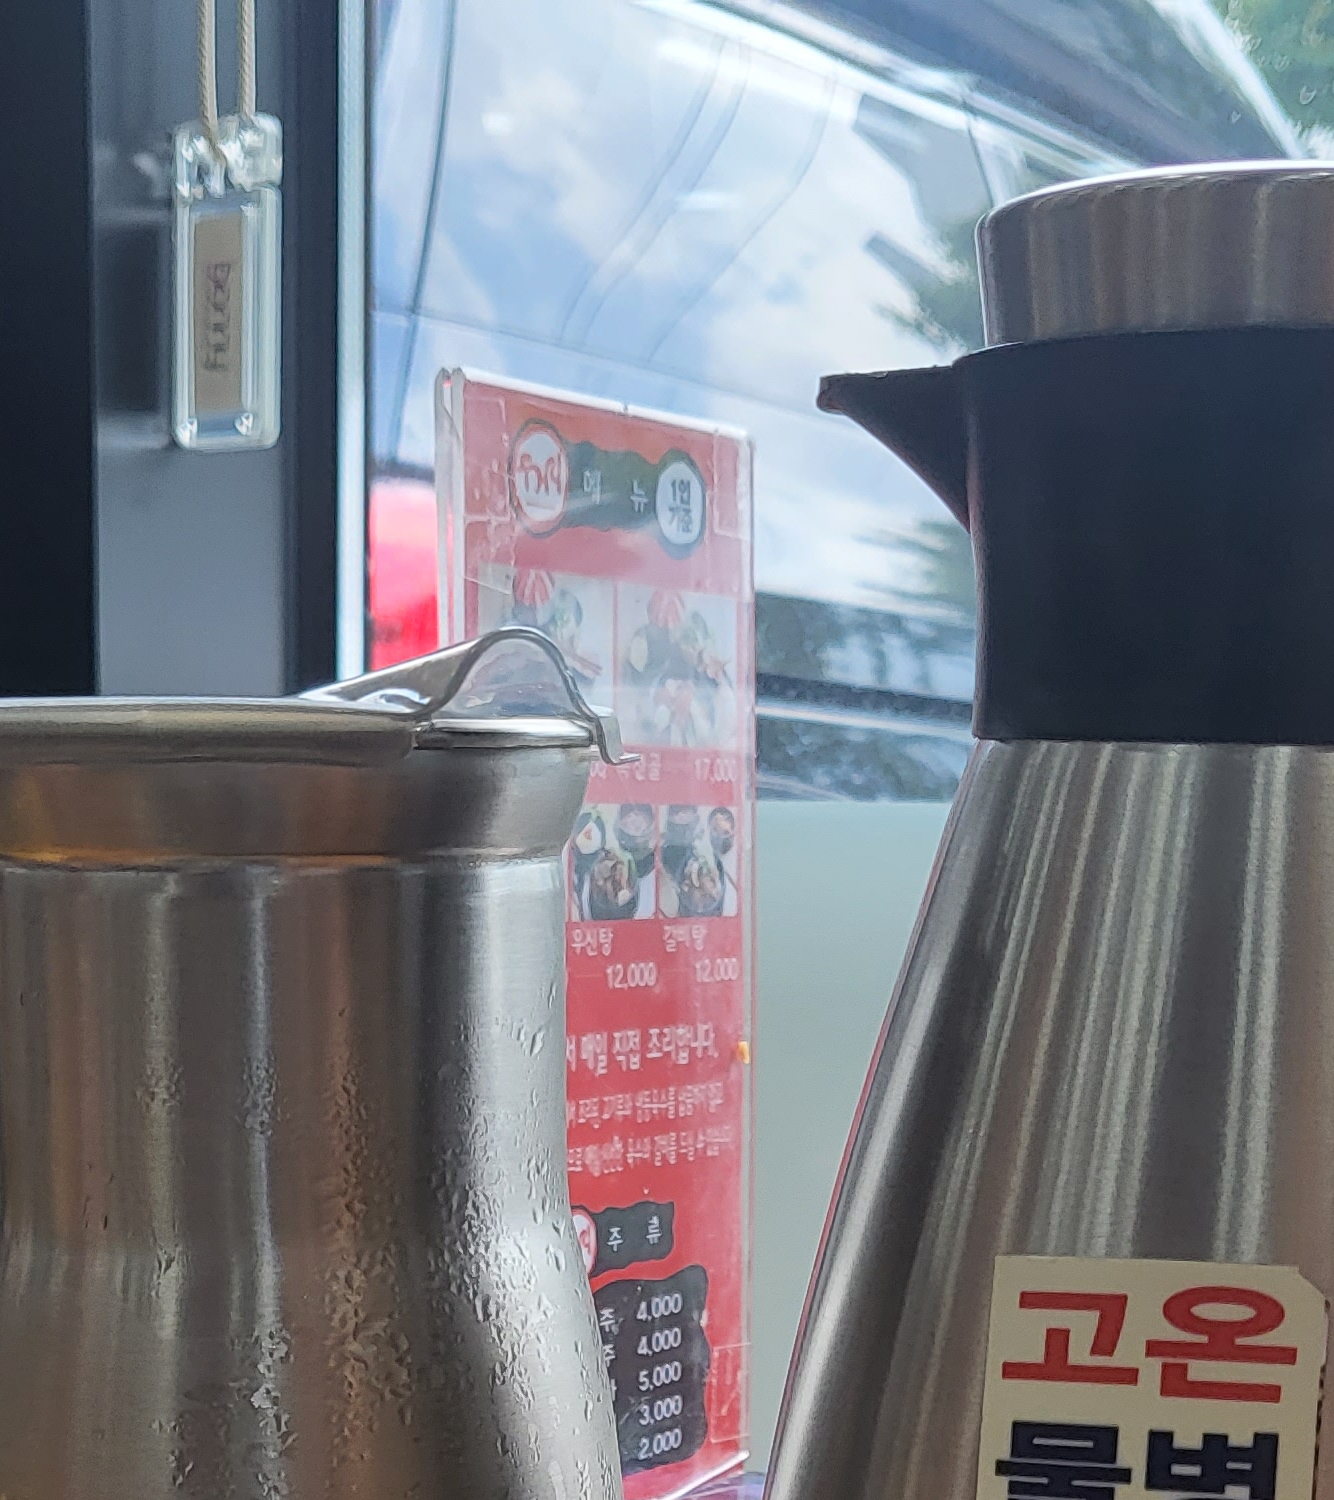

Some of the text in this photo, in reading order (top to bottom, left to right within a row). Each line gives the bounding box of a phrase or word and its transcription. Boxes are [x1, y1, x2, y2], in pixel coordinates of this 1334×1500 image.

[606, 961, 657, 991] 12,000
[695, 957, 739, 983] 12,000
[613, 1029, 641, 1072] 직접
[636, 1293, 683, 1322] 4,000
[636, 1327, 683, 1357] 4,000
[1001, 1285, 1298, 1404] 고온
[638, 1360, 682, 1391] 5,000
[638, 1394, 683, 1426] 3,000
[638, 1428, 683, 1460] 2,000
